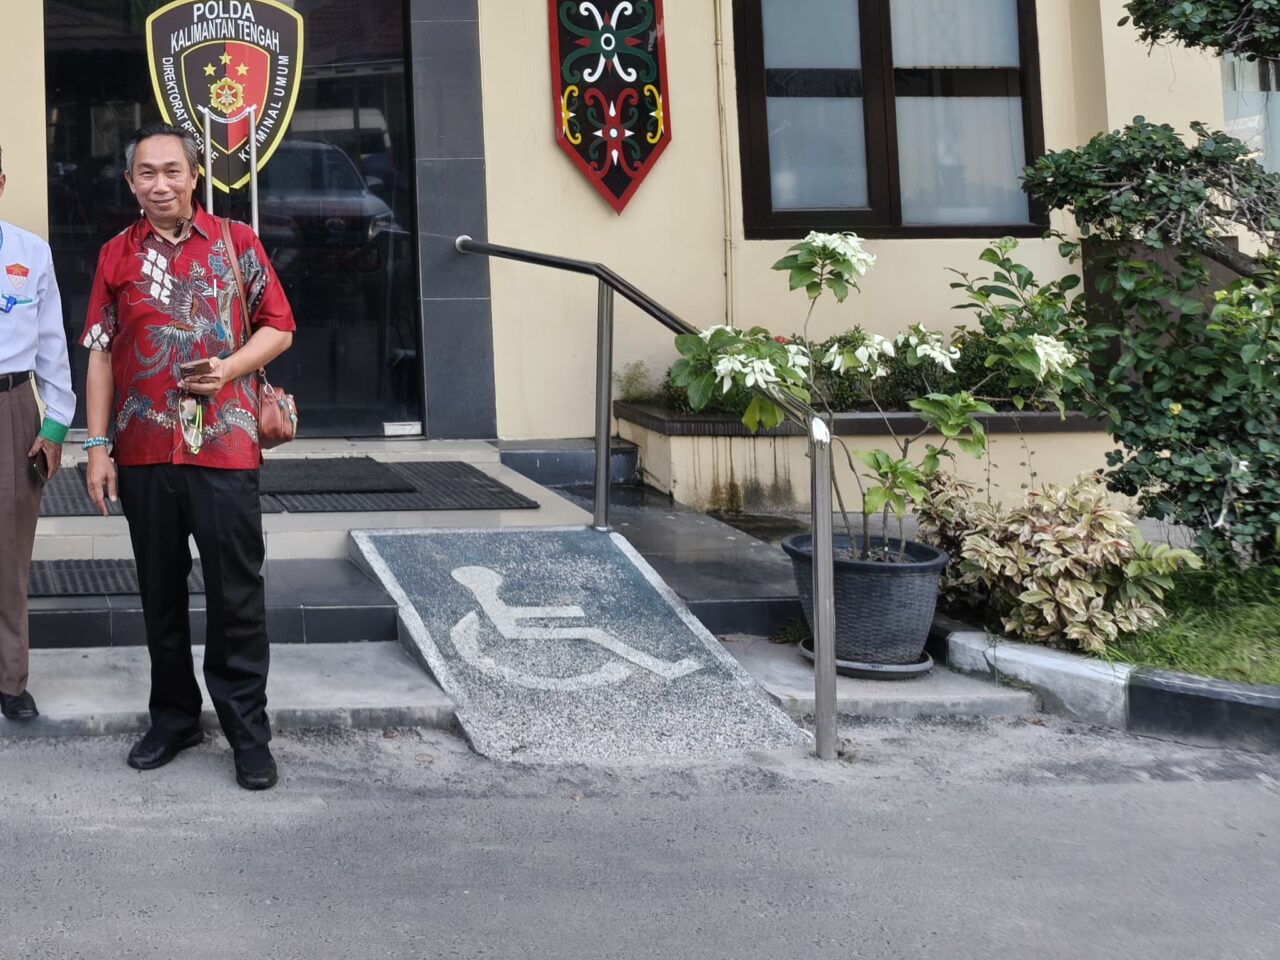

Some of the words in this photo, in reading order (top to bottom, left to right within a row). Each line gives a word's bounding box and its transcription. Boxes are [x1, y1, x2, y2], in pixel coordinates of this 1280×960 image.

[193, 1, 255, 23] POLDA
[170, 18, 235, 54] KALIMANTAN
[237, 20, 280, 53] TENGAH
[162, 57, 188, 123] DIREKTORAT
[273, 55, 290, 97] UMUM
